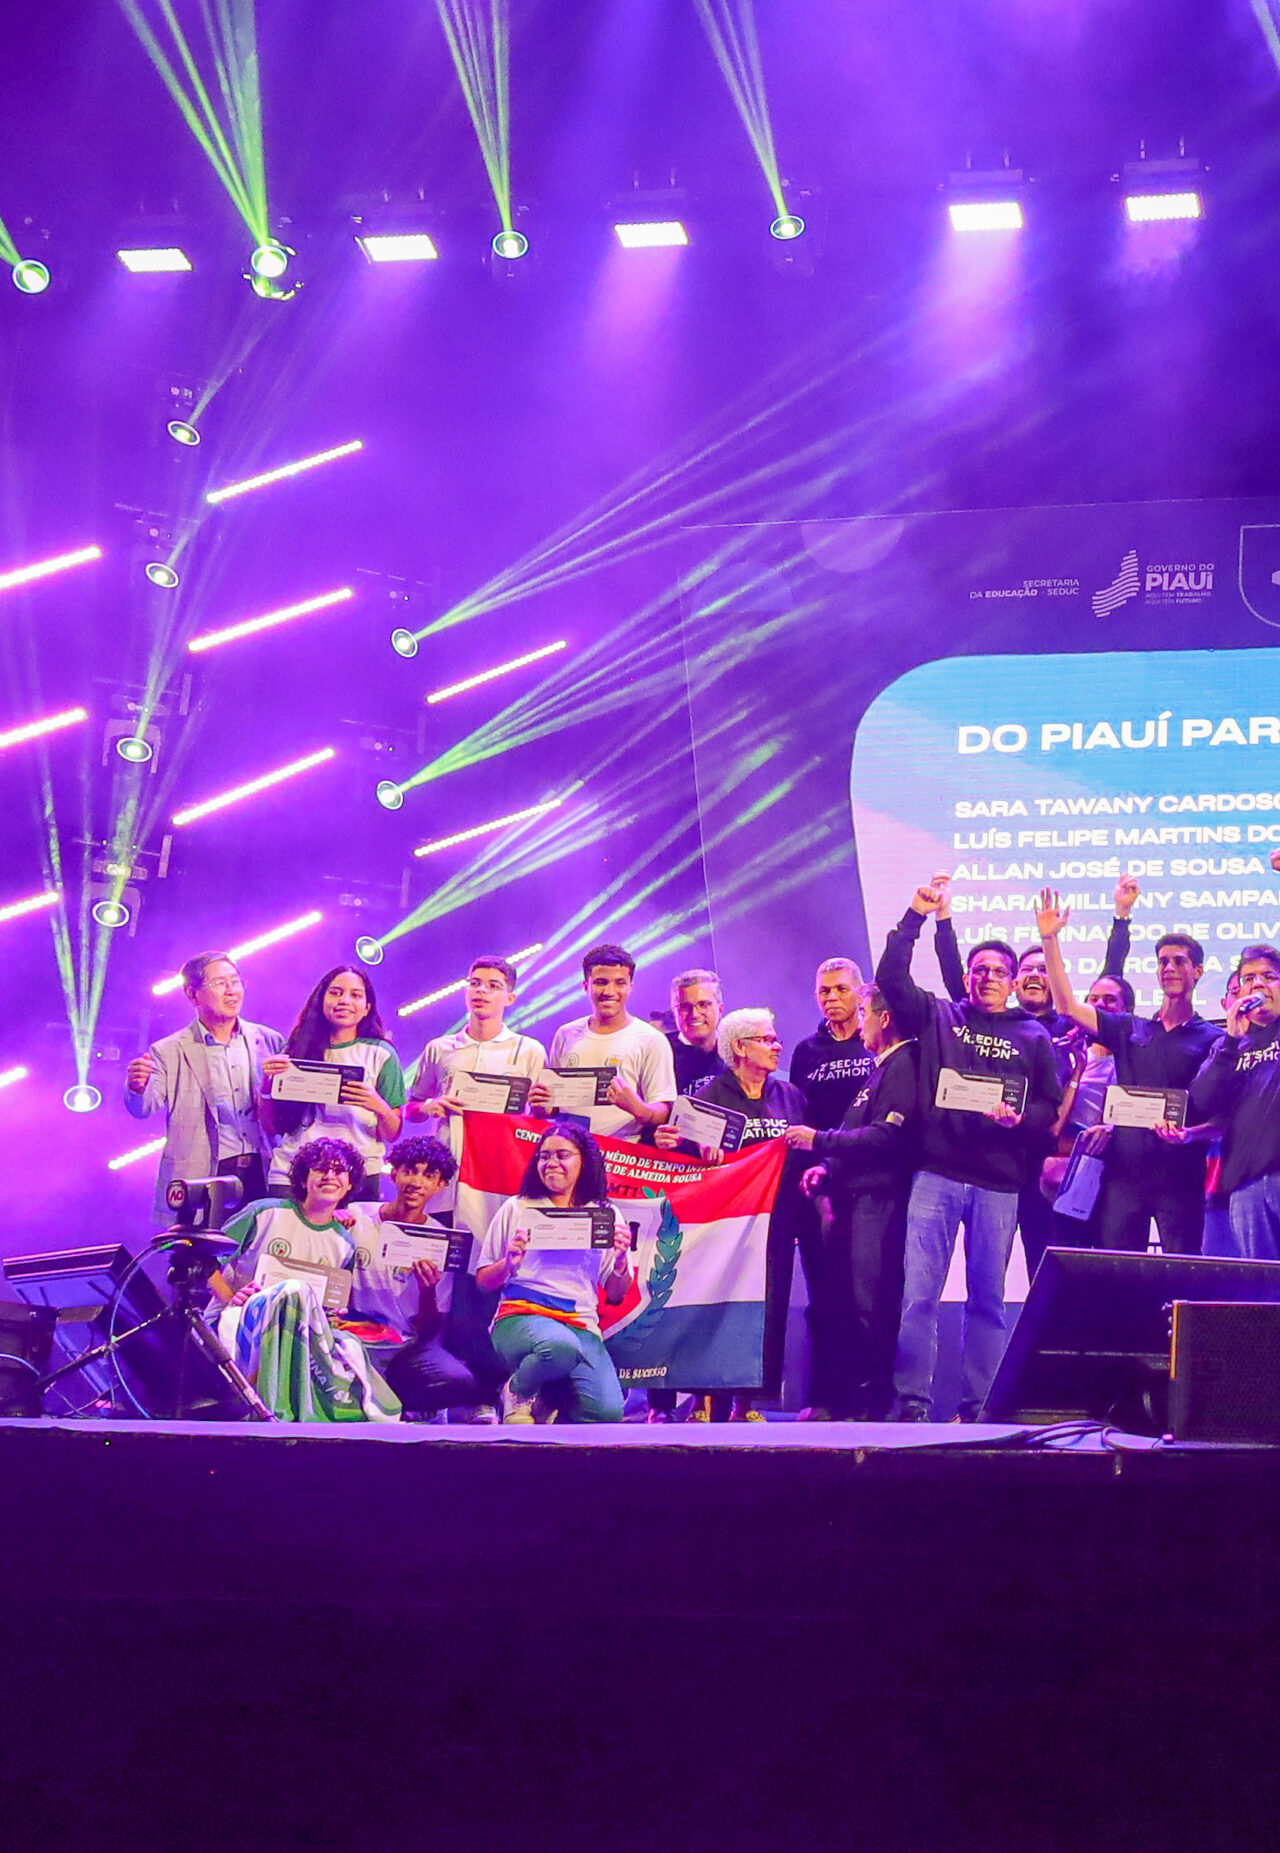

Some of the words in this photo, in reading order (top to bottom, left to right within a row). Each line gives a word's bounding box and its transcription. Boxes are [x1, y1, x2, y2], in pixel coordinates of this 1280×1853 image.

[1146, 564, 1196, 572] GOVERNO
[1199, 563, 1215, 571] DO
[1023, 578, 1080, 588] SECRETARIA
[1145, 571, 1213, 591] PIAUÍ
[969, 591, 983, 599] DA
[985, 588, 1038, 599] EDUCAÇÃO
[1047, 587, 1079, 597] SEDUC
[957, 723, 1028, 755] DO
[1040, 710, 1173, 752] PIAUÍ
[954, 799, 1029, 819] SARA
[1033, 795, 1154, 816] TAWANY
[953, 827, 1012, 850] LUÍS
[1017, 829, 1109, 848] FELIPE
[1114, 825, 1241, 847] MARTINS
[951, 861, 1043, 881] ALLAN
[1049, 856, 1121, 879] JOSÉ
[1127, 859, 1165, 877] DE
[1169, 857, 1265, 877] SOUSA
[1059, 890, 1174, 911] MILLNY
[1013, 923, 1168, 943] FERNADO
[1173, 922, 1210, 941] DE
[605, 1149, 637, 1166] MÉDIO
[636, 1157, 652, 1169] DE
[652, 1160, 686, 1173] TEMPO
[612, 1165, 628, 1176] DE
[627, 1168, 671, 1183] ALMEIDA
[672, 1172, 702, 1184] SOUSA
[619, 1368, 632, 1379] DE
